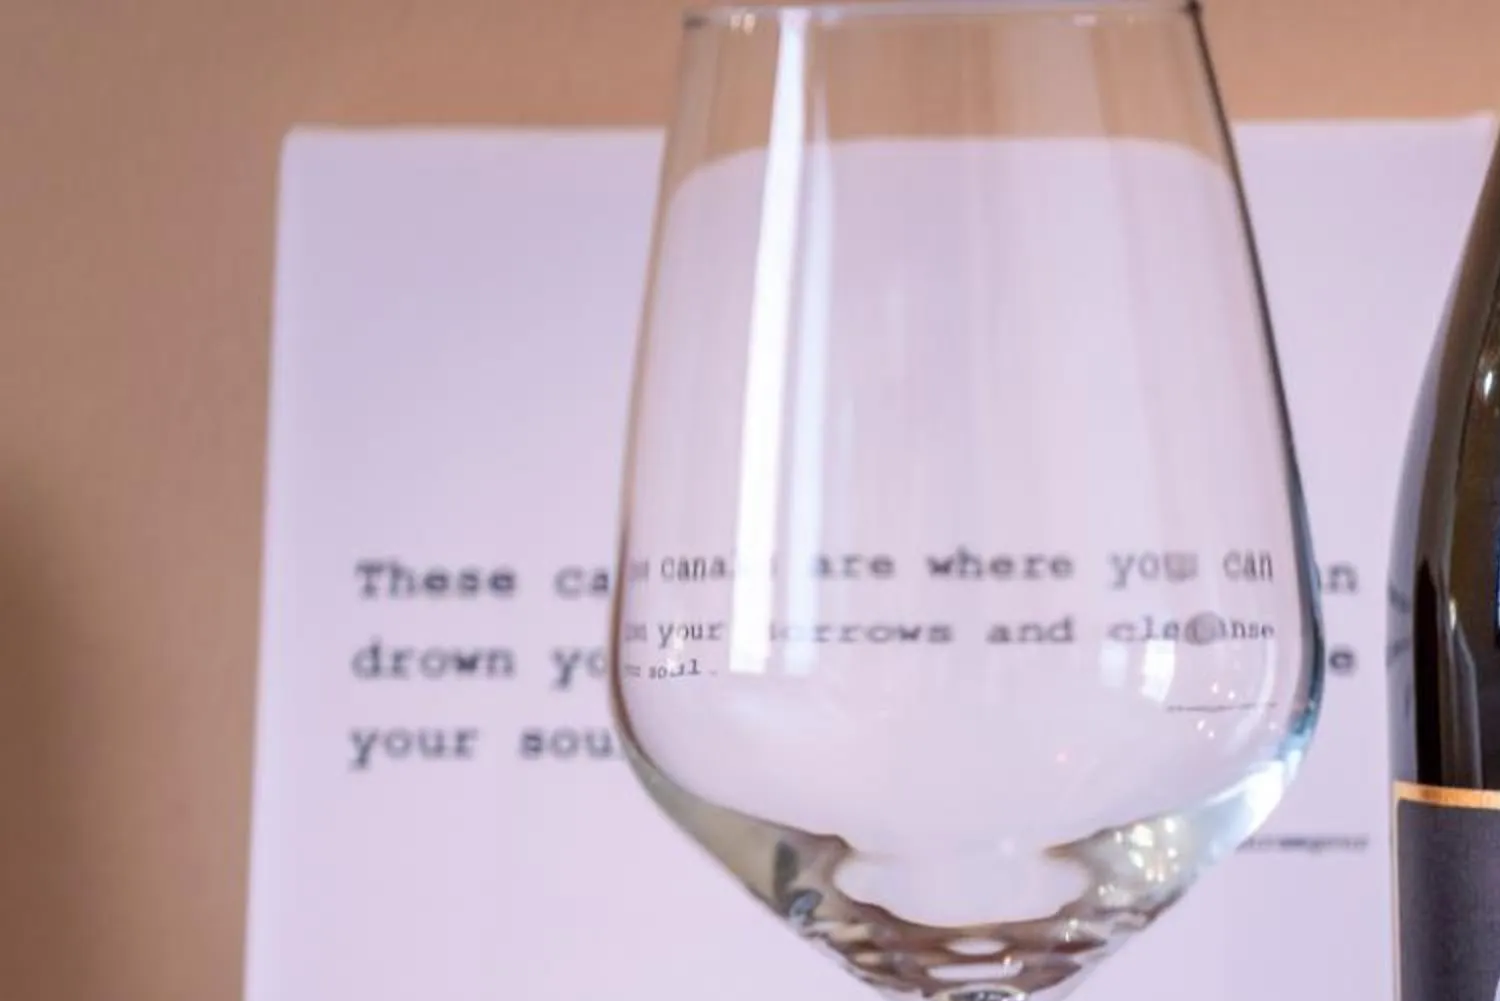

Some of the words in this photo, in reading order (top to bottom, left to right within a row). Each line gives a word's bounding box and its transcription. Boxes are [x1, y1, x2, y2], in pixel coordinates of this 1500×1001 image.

[354, 559, 517, 598] These
[926, 545, 1075, 580] where
[1221, 550, 1273, 581] can
[767, 621, 954, 645] orrows
[986, 616, 1076, 645] and
[351, 639, 516, 679] drown
[349, 727, 479, 770] your
[519, 727, 626, 760] sou
